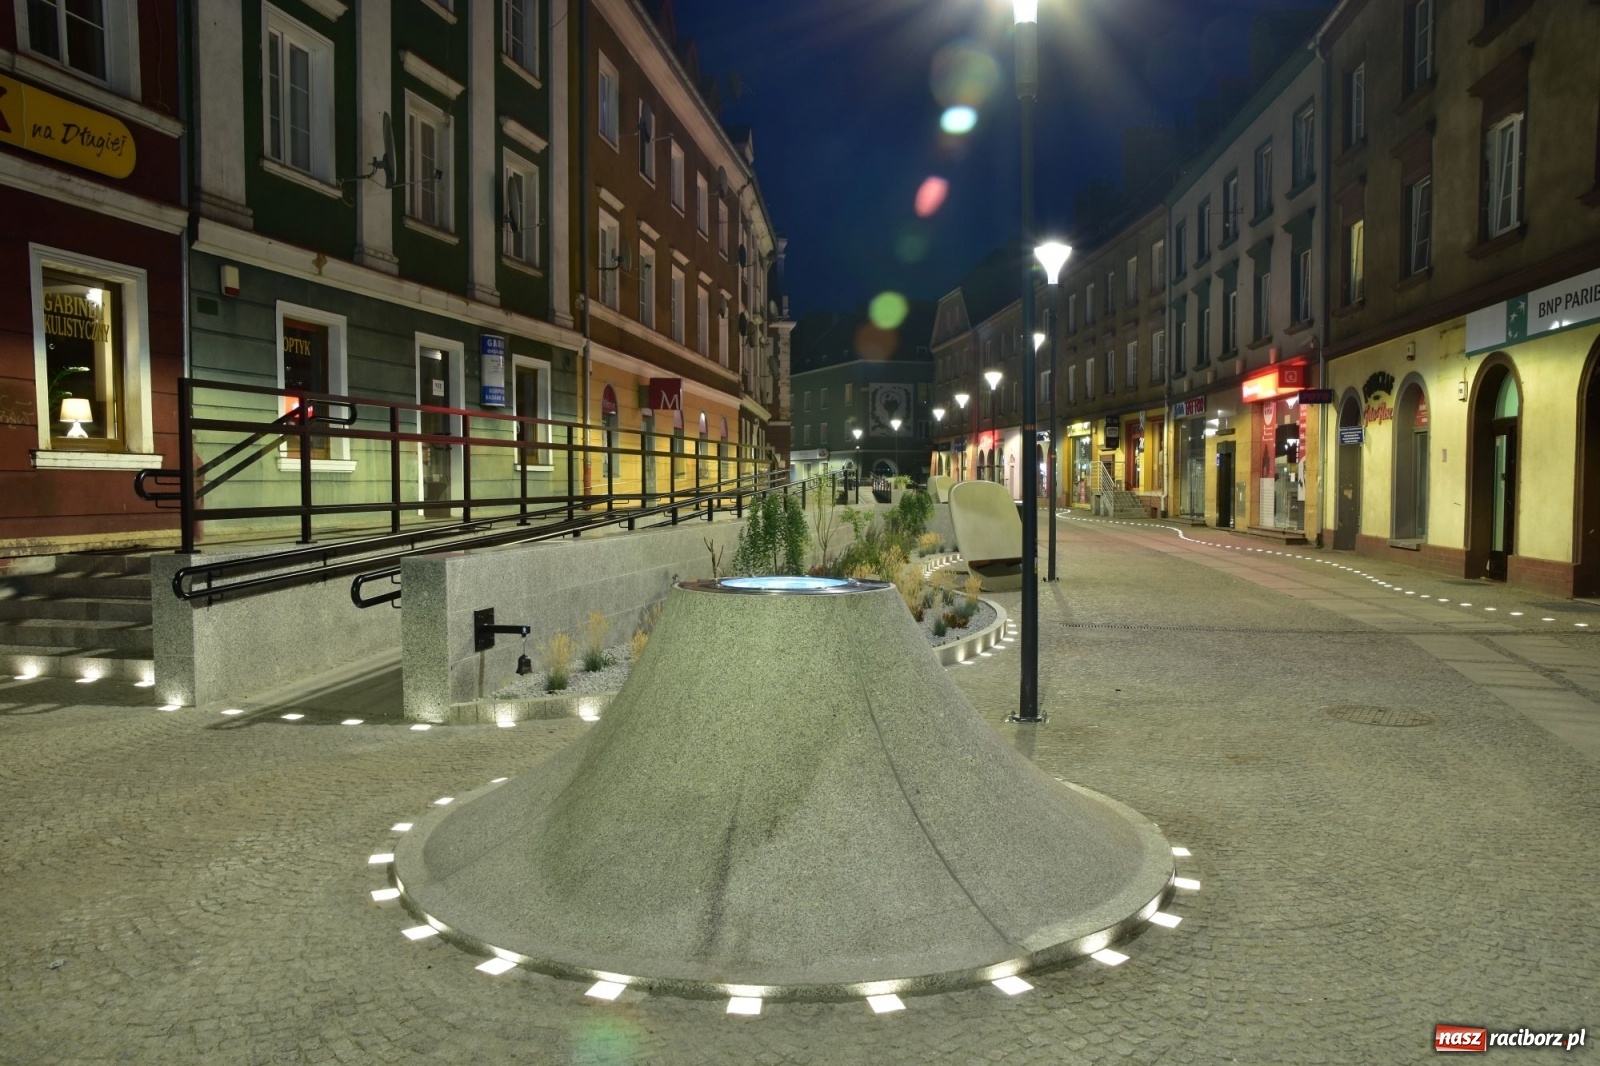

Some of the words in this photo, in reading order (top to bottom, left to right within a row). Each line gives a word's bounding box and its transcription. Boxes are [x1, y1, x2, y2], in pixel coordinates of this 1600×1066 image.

[31, 123, 55, 140] na
[60, 123, 127, 157] Długiej
[1538, 296, 1562, 318] BNP
[1565, 283, 1600, 310] PARIB
[283, 336, 311, 356] OPTYK
